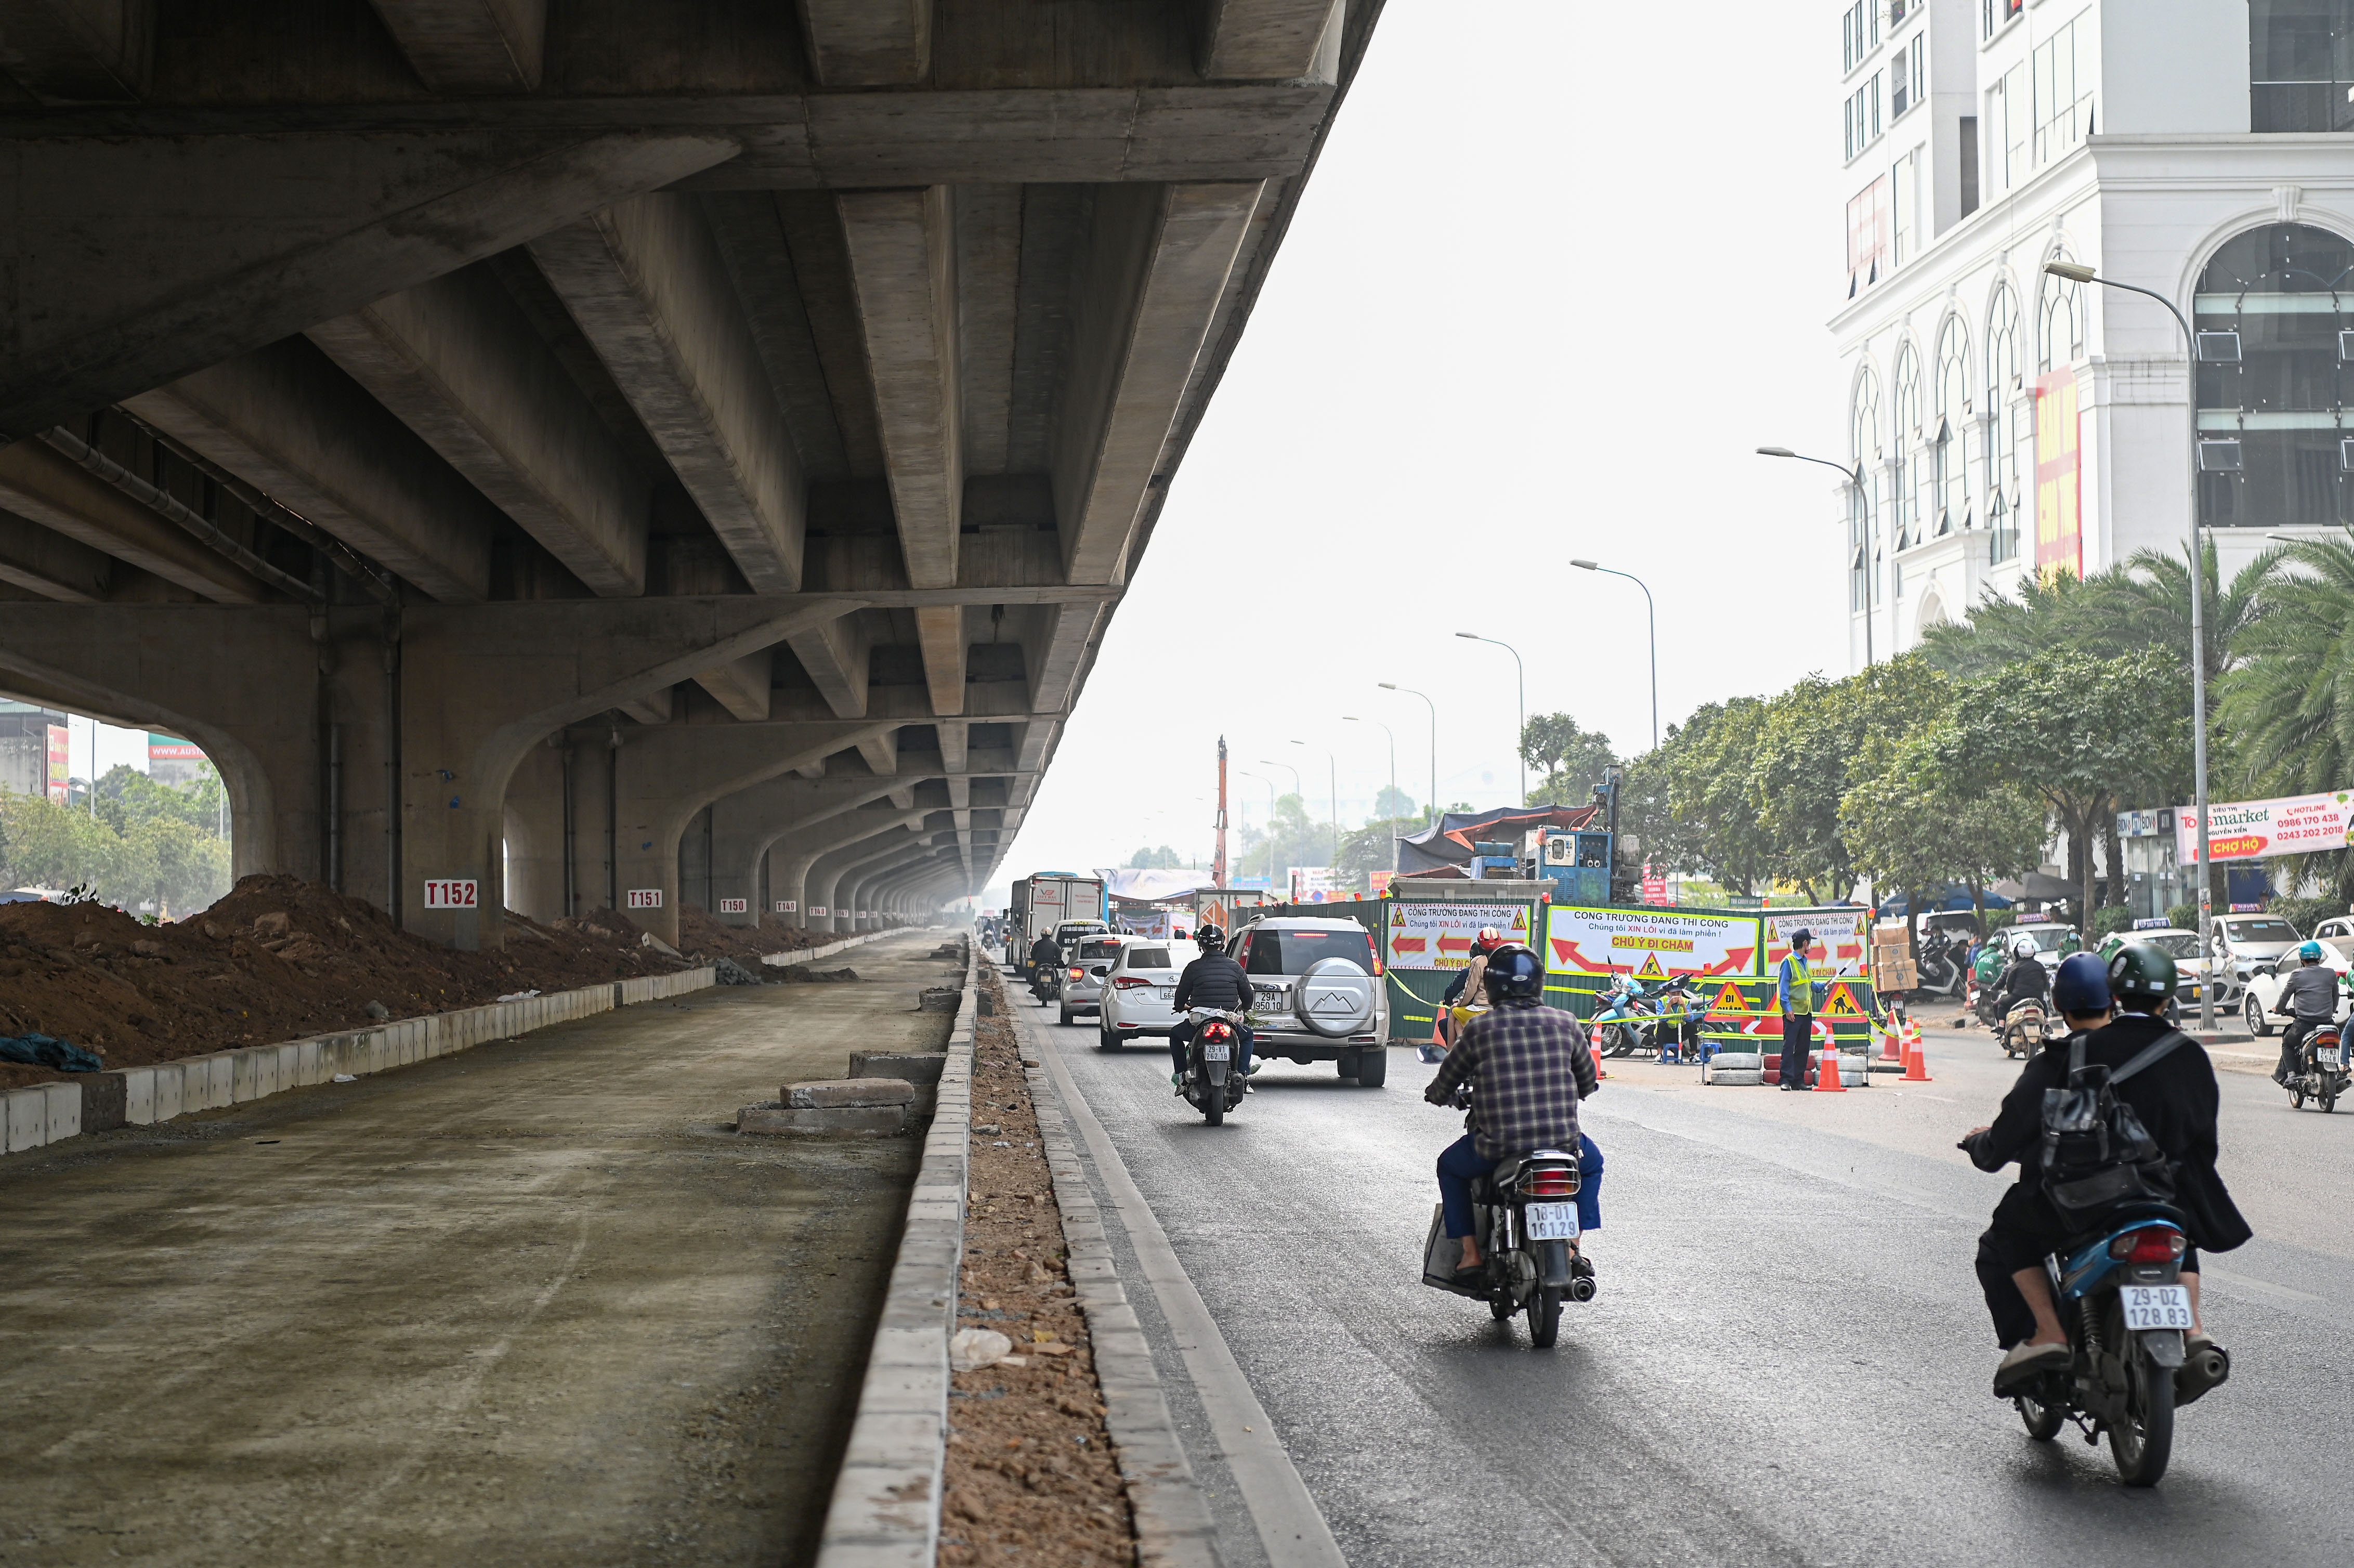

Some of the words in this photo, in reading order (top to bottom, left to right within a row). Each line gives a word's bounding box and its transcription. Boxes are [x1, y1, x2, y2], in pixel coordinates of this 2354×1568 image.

[2039, 479, 2058, 546] CHO
[2294, 804, 2326, 814] HOTLINE
[2117, 819, 2128, 832] BIDV
[2132, 817, 2141, 832] ATM
[2142, 815, 2152, 829] BIDV
[2161, 813, 2170, 828] ATM
[2277, 818, 2301, 828] 0986
[2303, 816, 2319, 826] 170
[2322, 813, 2339, 822] 438
[2277, 831, 2300, 841] 0243
[2303, 828, 2321, 838] 202
[2323, 826, 2343, 835] 2018
[2214, 840, 2240, 854] CHỢ
[2242, 837, 2259, 852] HỘ
[427, 882, 475, 905] T152
[630, 891, 660, 907] T151
[722, 900, 743, 911] T150
[777, 902, 794, 911] T149
[1408, 906, 1427, 917] CÔNG
[1428, 907, 1457, 917] TRƯỜNG
[1459, 909, 1478, 917] ĐANG
[1492, 908, 1511, 918] CÔNG
[1409, 920, 1429, 929] Chúng
[1450, 919, 1461, 928] LỖI
[1651, 916, 1679, 925] ĐANG
[1682, 918, 1697, 926] THI
[1815, 917, 1829, 926] ĐANG
[1588, 922, 1614, 932] Chúng
[1643, 924, 1657, 934] LỖI
[1667, 926, 1677, 935] đã
[1679, 927, 1693, 936] làm
[1695, 929, 1717, 938] phiền
[1612, 936, 1635, 947] CHÚ
[1638, 936, 1645, 948] Ý
[1647, 939, 1659, 949] ĐI
[1662, 939, 1694, 952] CHẬM
[1434, 958, 1449, 967] CHÚ
[1449, 958, 1455, 967] Ý
[1456, 959, 1463, 968] ĐI
[1261, 992, 1276, 1001] 29A
[1725, 994, 1734, 1003] ĐI
[1256, 1001, 1281, 1010] 950.10
[1532, 1221, 1576, 1237] 181.29
[2131, 1288, 2180, 1306] 29-D2
[2129, 1308, 2188, 1326] 128.83
